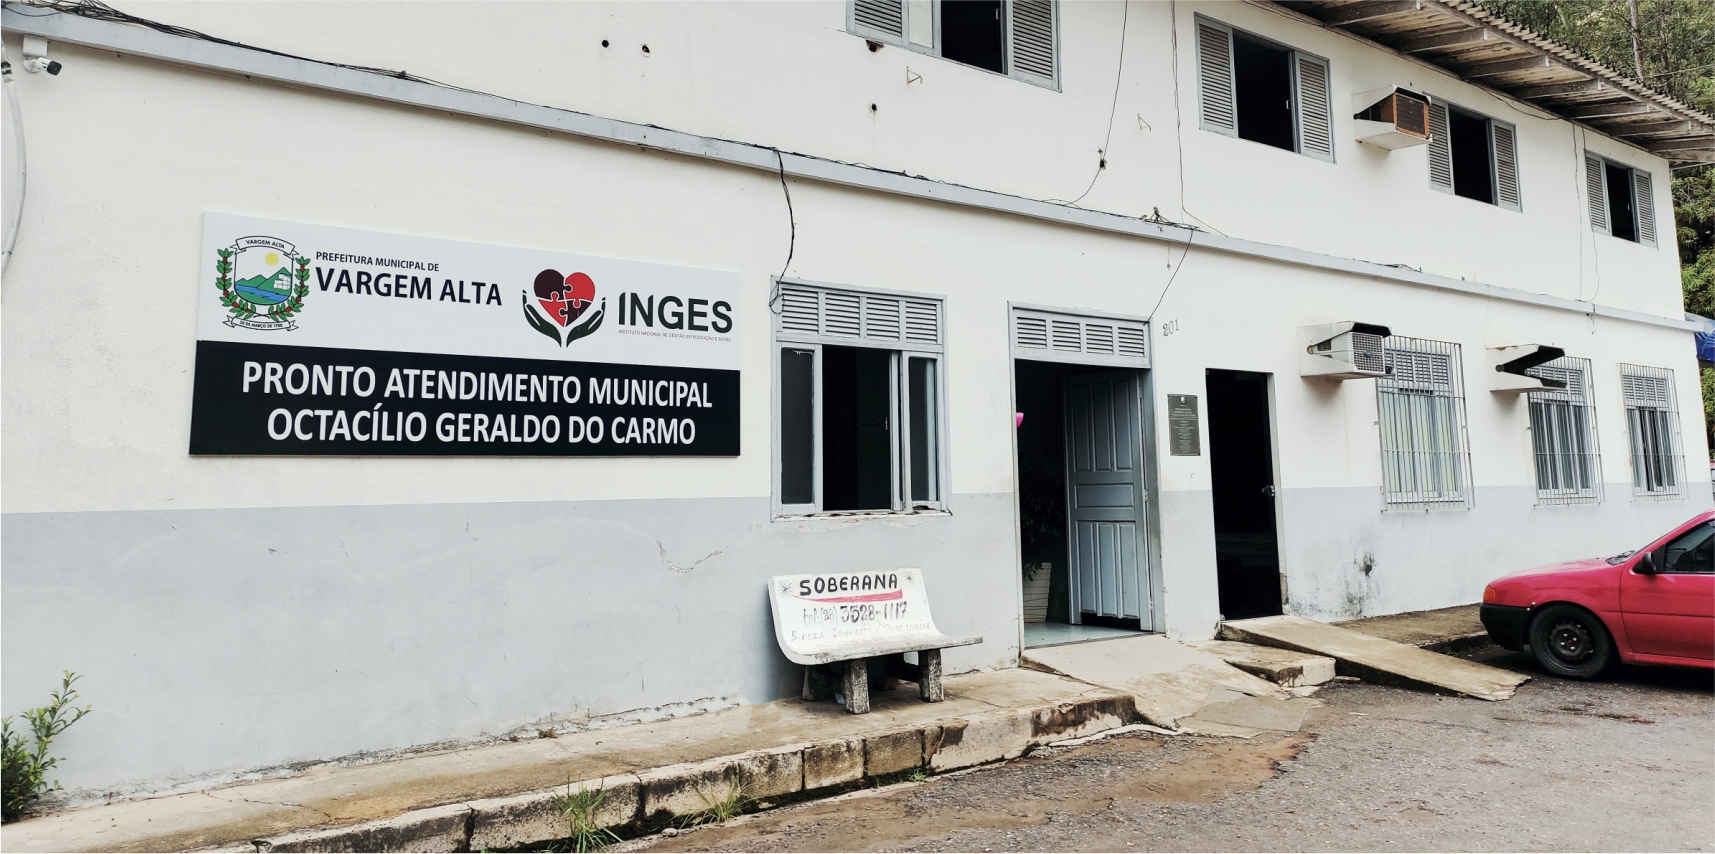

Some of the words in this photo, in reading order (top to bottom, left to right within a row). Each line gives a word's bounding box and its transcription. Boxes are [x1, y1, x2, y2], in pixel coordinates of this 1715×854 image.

[315, 251, 373, 265] PREFEITURA
[374, 257, 425, 270] MUNICIPAL
[426, 262, 440, 272] DE
[315, 266, 433, 300] VARGEM
[439, 278, 503, 306] ALTA
[618, 291, 733, 334] INGES
[1162, 318, 1180, 336] 201
[242, 361, 376, 398] PRONTO
[383, 368, 581, 404] ATENDIMENTO
[589, 377, 713, 408] MUNICIPAL
[267, 402, 427, 442] OCTACÍLIO
[435, 412, 561, 444] GERALDO
[568, 415, 604, 444] DO
[611, 416, 696, 445] CARMO
[799, 572, 898, 597] SOBERANA
[840, 601, 907, 623] 3528-1117
